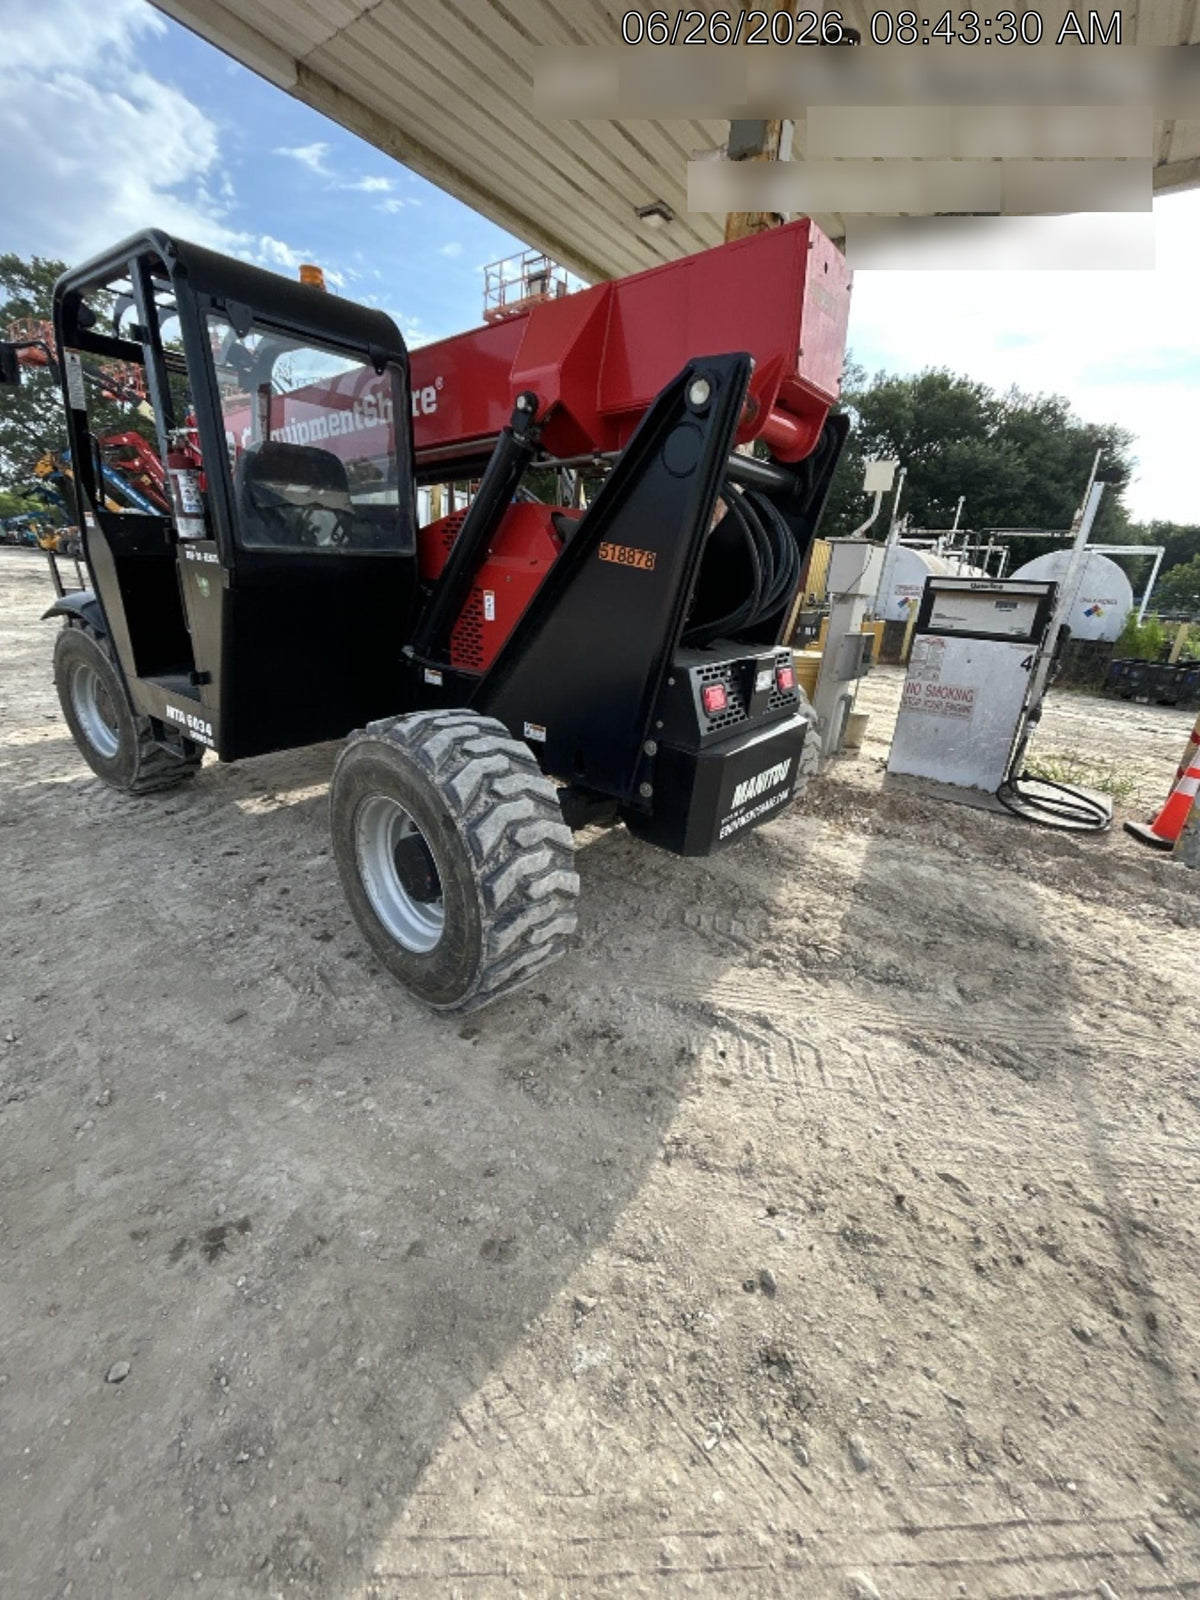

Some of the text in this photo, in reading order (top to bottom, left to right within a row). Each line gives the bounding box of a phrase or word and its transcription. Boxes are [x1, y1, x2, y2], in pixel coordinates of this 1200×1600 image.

[599, 543, 655, 568] 518878
[1020, 654, 1034, 672] 4
[905, 681, 974, 703] NO SMOKING
[166, 704, 186, 725] MTA
[730, 757, 792, 810] MANITOU
